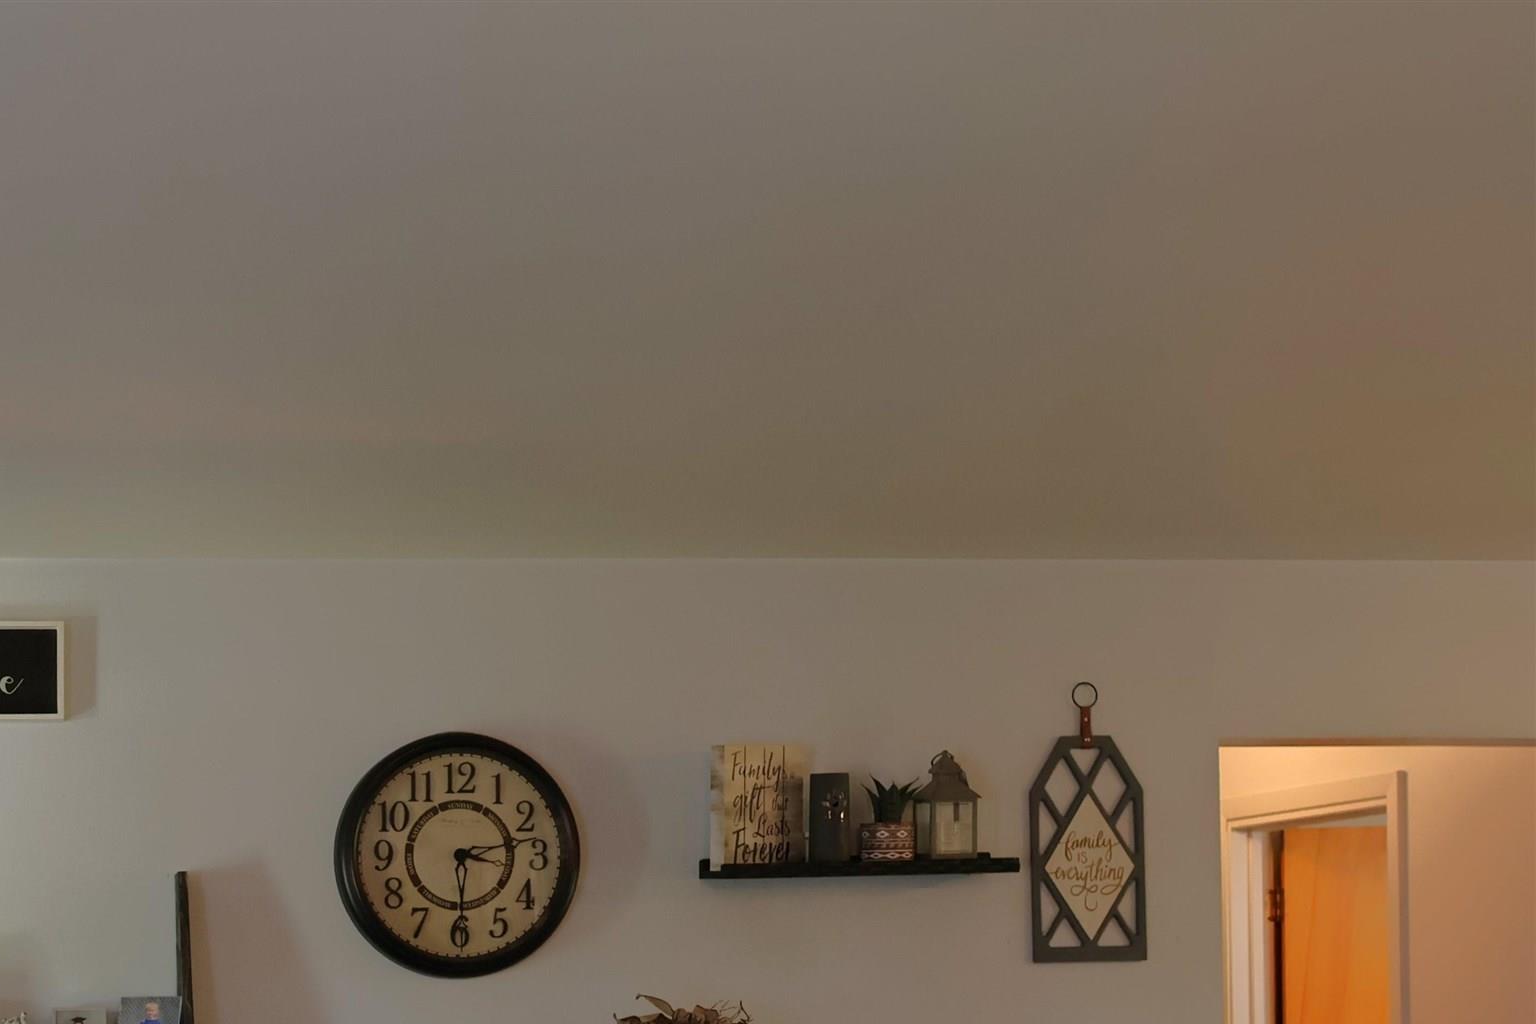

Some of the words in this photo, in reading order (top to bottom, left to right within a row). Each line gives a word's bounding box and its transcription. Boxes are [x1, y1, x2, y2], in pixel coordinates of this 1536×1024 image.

[407, 770, 433, 802] 11
[443, 761, 476, 794] 12
[731, 751, 784, 792] Family
[491, 773, 504, 805] 1
[377, 801, 410, 832] 10
[515, 800, 535, 832] 2
[374, 839, 394, 871] 9
[529, 839, 548, 871] 3
[1059, 830, 1119, 862] family
[384, 877, 403, 909] 8
[1050, 859, 1124, 895] everything
[515, 878, 535, 910] 4
[411, 907, 429, 939] 7
[450, 915, 470, 948] 6
[489, 907, 508, 939] 5
